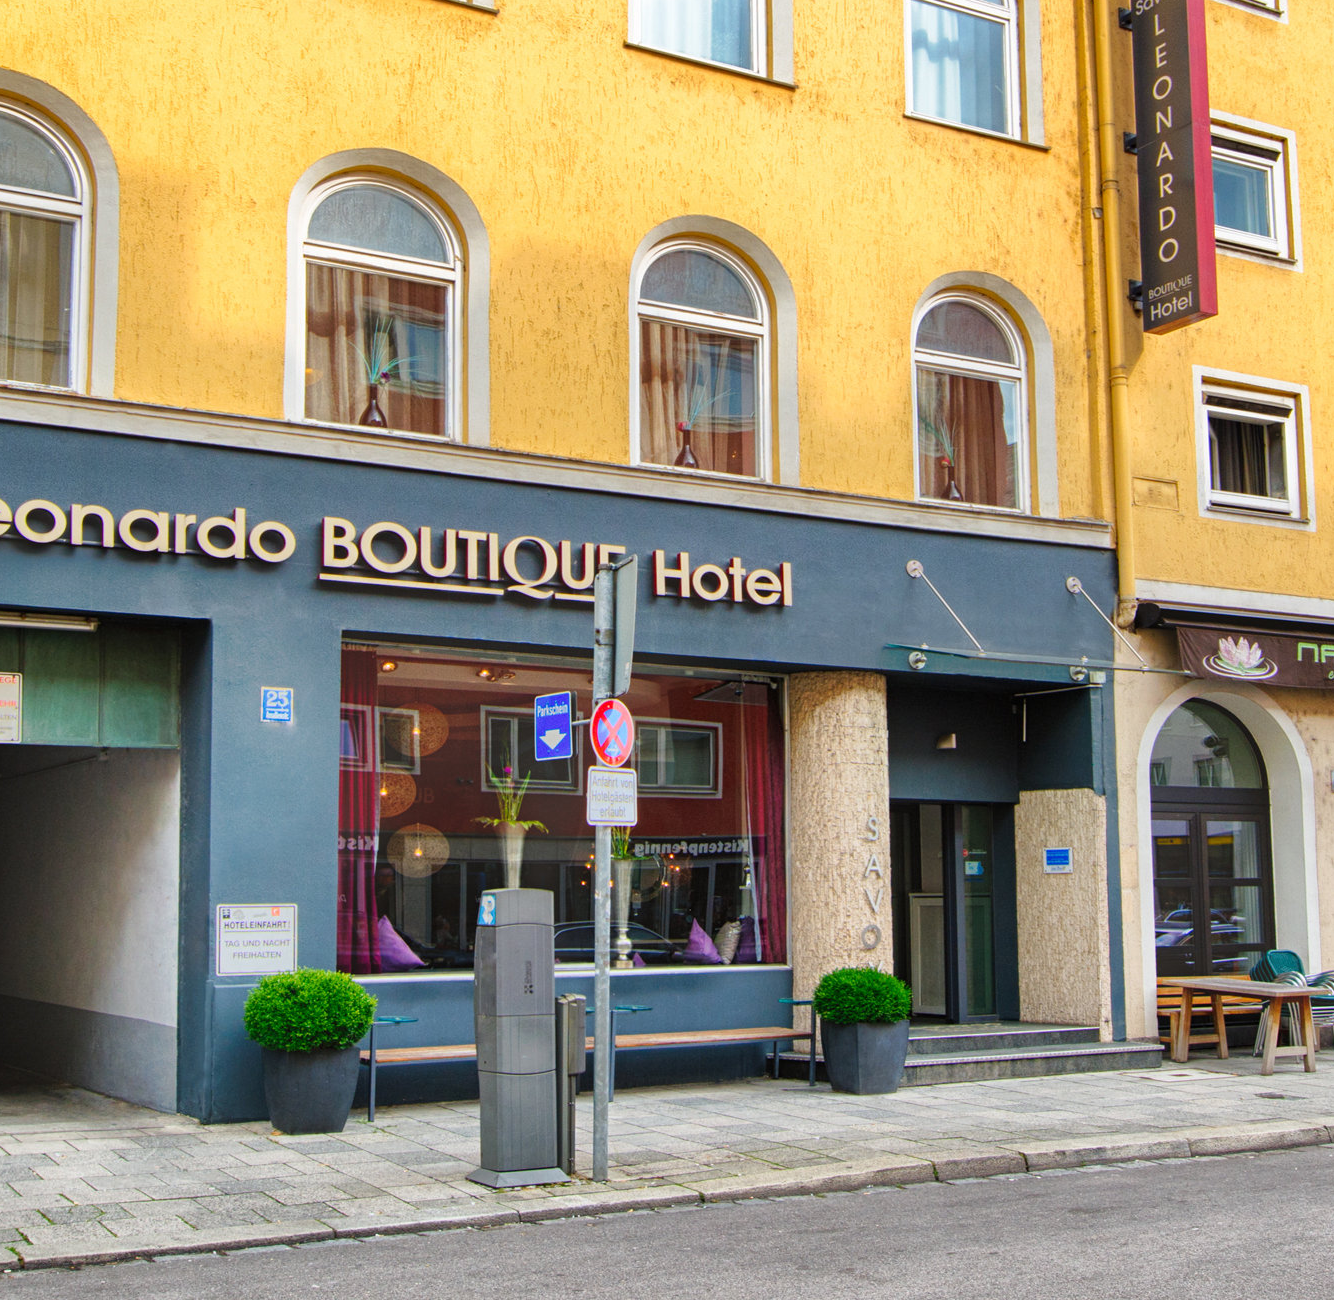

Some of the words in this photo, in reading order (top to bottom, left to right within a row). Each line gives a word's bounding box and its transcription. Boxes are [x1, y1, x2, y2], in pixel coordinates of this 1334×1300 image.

[1152, 14, 1179, 263] LEONARDO
[1148, 275, 1192, 299] BOUTIQUE
[1150, 291, 1192, 321] Hotel
[653, 550, 793, 608] Hotel
[267, 691, 288, 707] 25
[537, 703, 568, 717] Parkschein
[593, 776, 618, 788] Anfahrt
[621, 780, 633, 788] von
[592, 791, 633, 805] Hotelgästen
[600, 806, 626, 818] erlaubt
[263, 939, 290, 947] NACHT
[233, 951, 281, 959] FREIHALTEN
